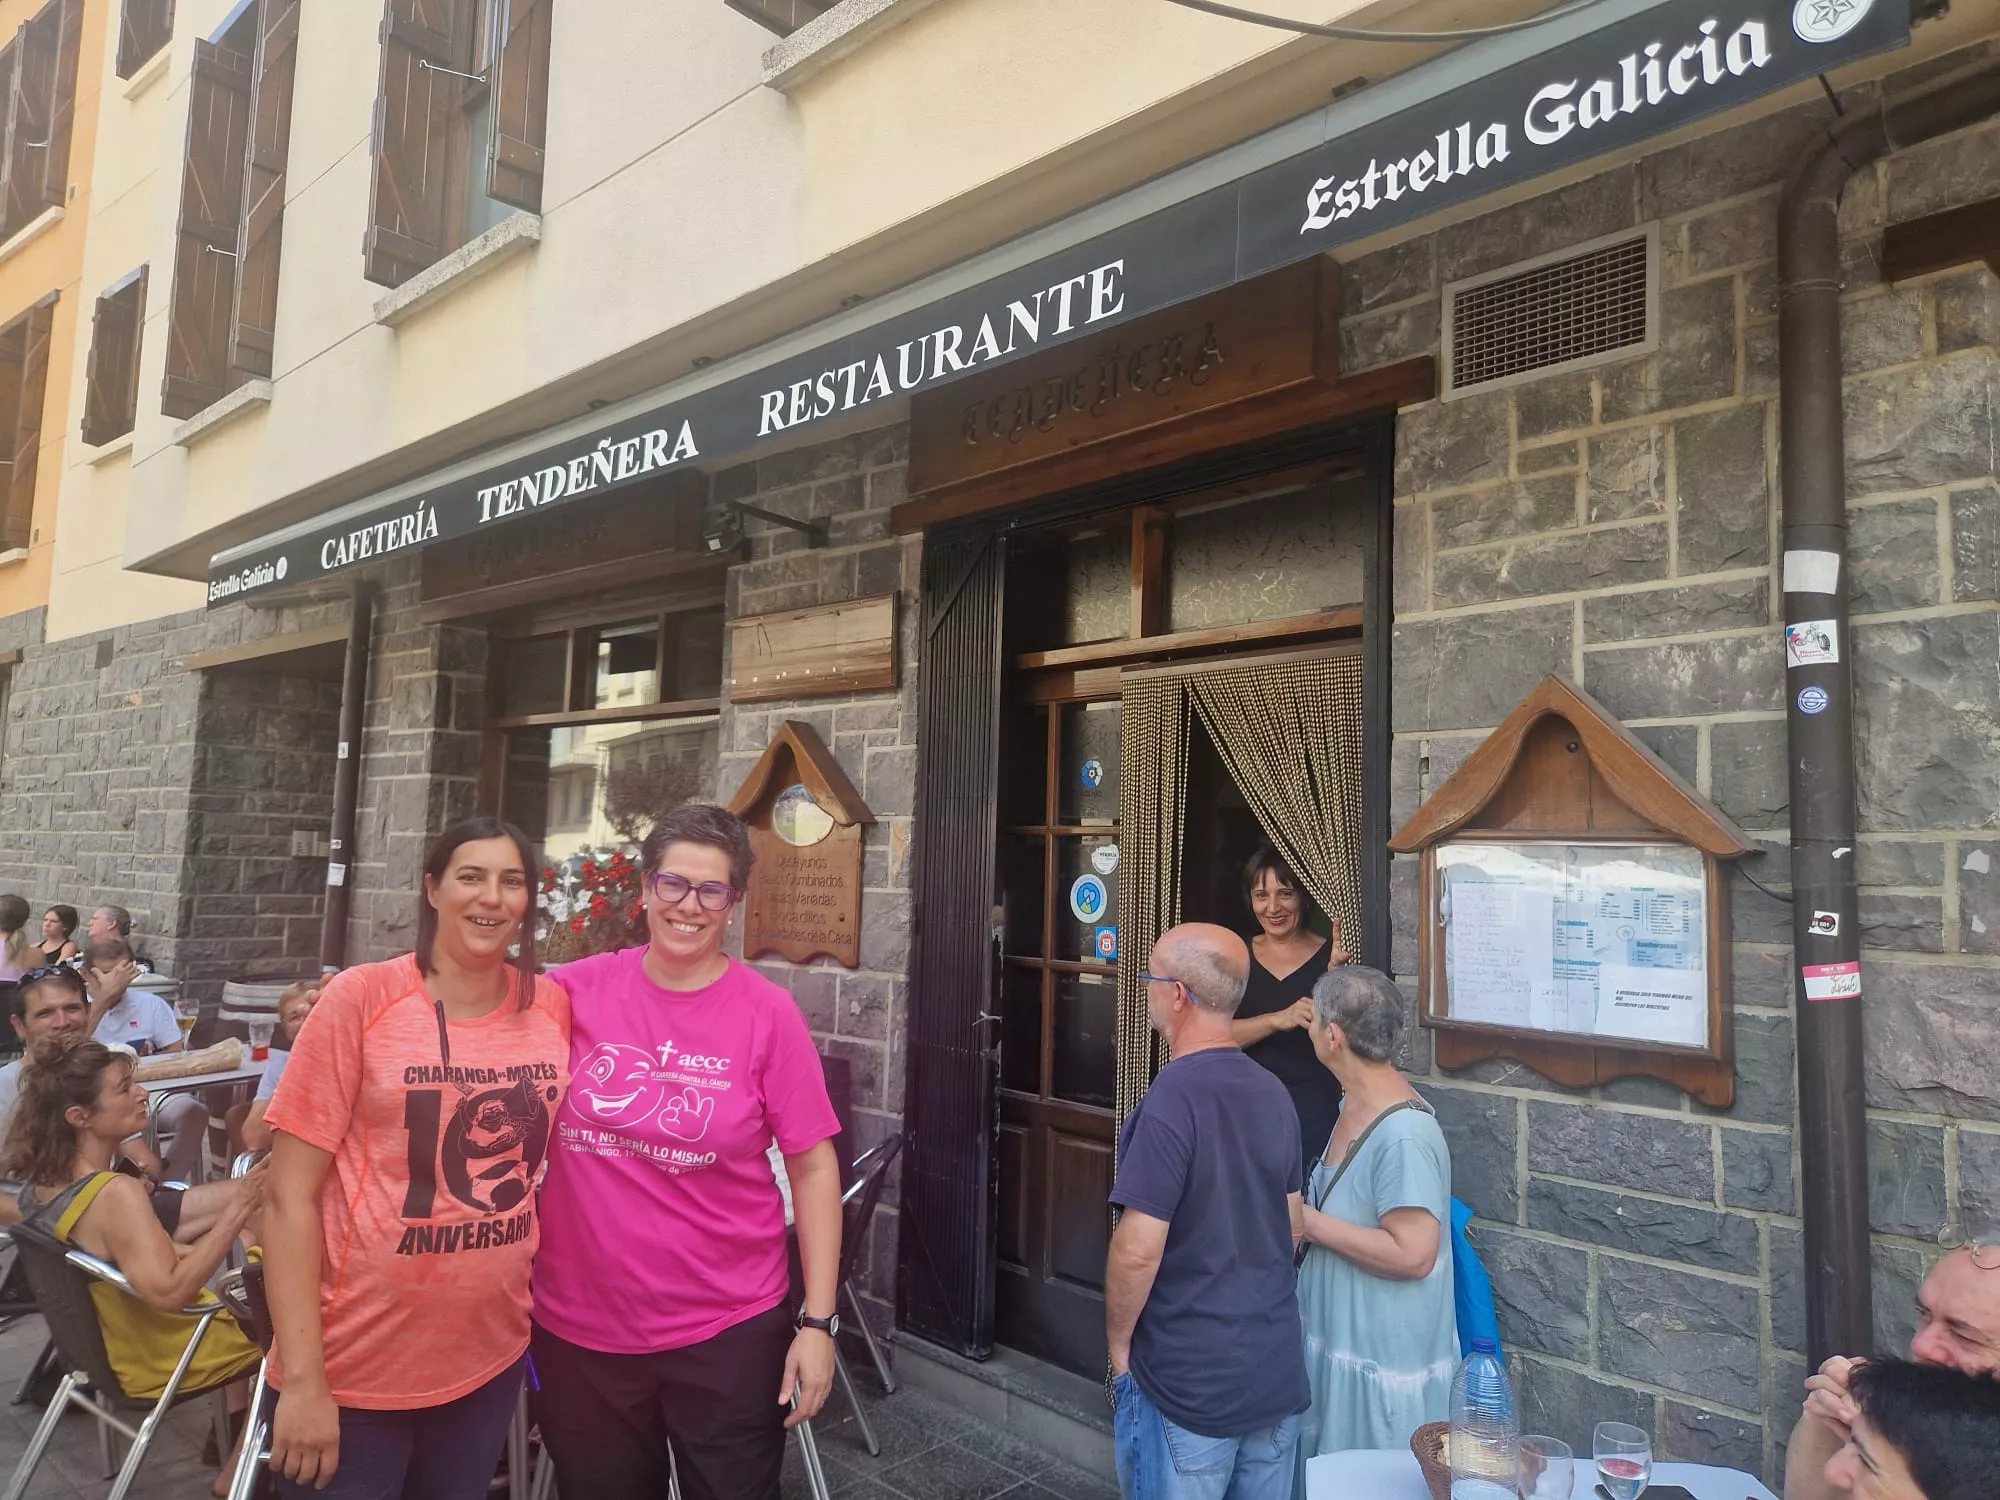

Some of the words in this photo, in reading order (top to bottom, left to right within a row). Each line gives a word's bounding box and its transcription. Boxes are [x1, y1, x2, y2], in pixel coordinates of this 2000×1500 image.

[1299, 121, 1511, 235] Estrella
[1523, 19, 1772, 146] Galicia
[320, 500, 439, 570] CAFETERÍA
[477, 419, 699, 523] TENDEÑERA
[756, 258, 1125, 437] RESTAURANTE
[208, 574, 240, 601] Estrella
[241, 562, 274, 591] Galicia
[404, 1065, 498, 1085] CHARANGA
[506, 1060, 558, 1082] MOZÉS
[678, 1054, 731, 1071] aecc
[600, 1132, 617, 1144] NO
[653, 1145, 668, 1158] LO
[671, 1149, 717, 1164] MISMO
